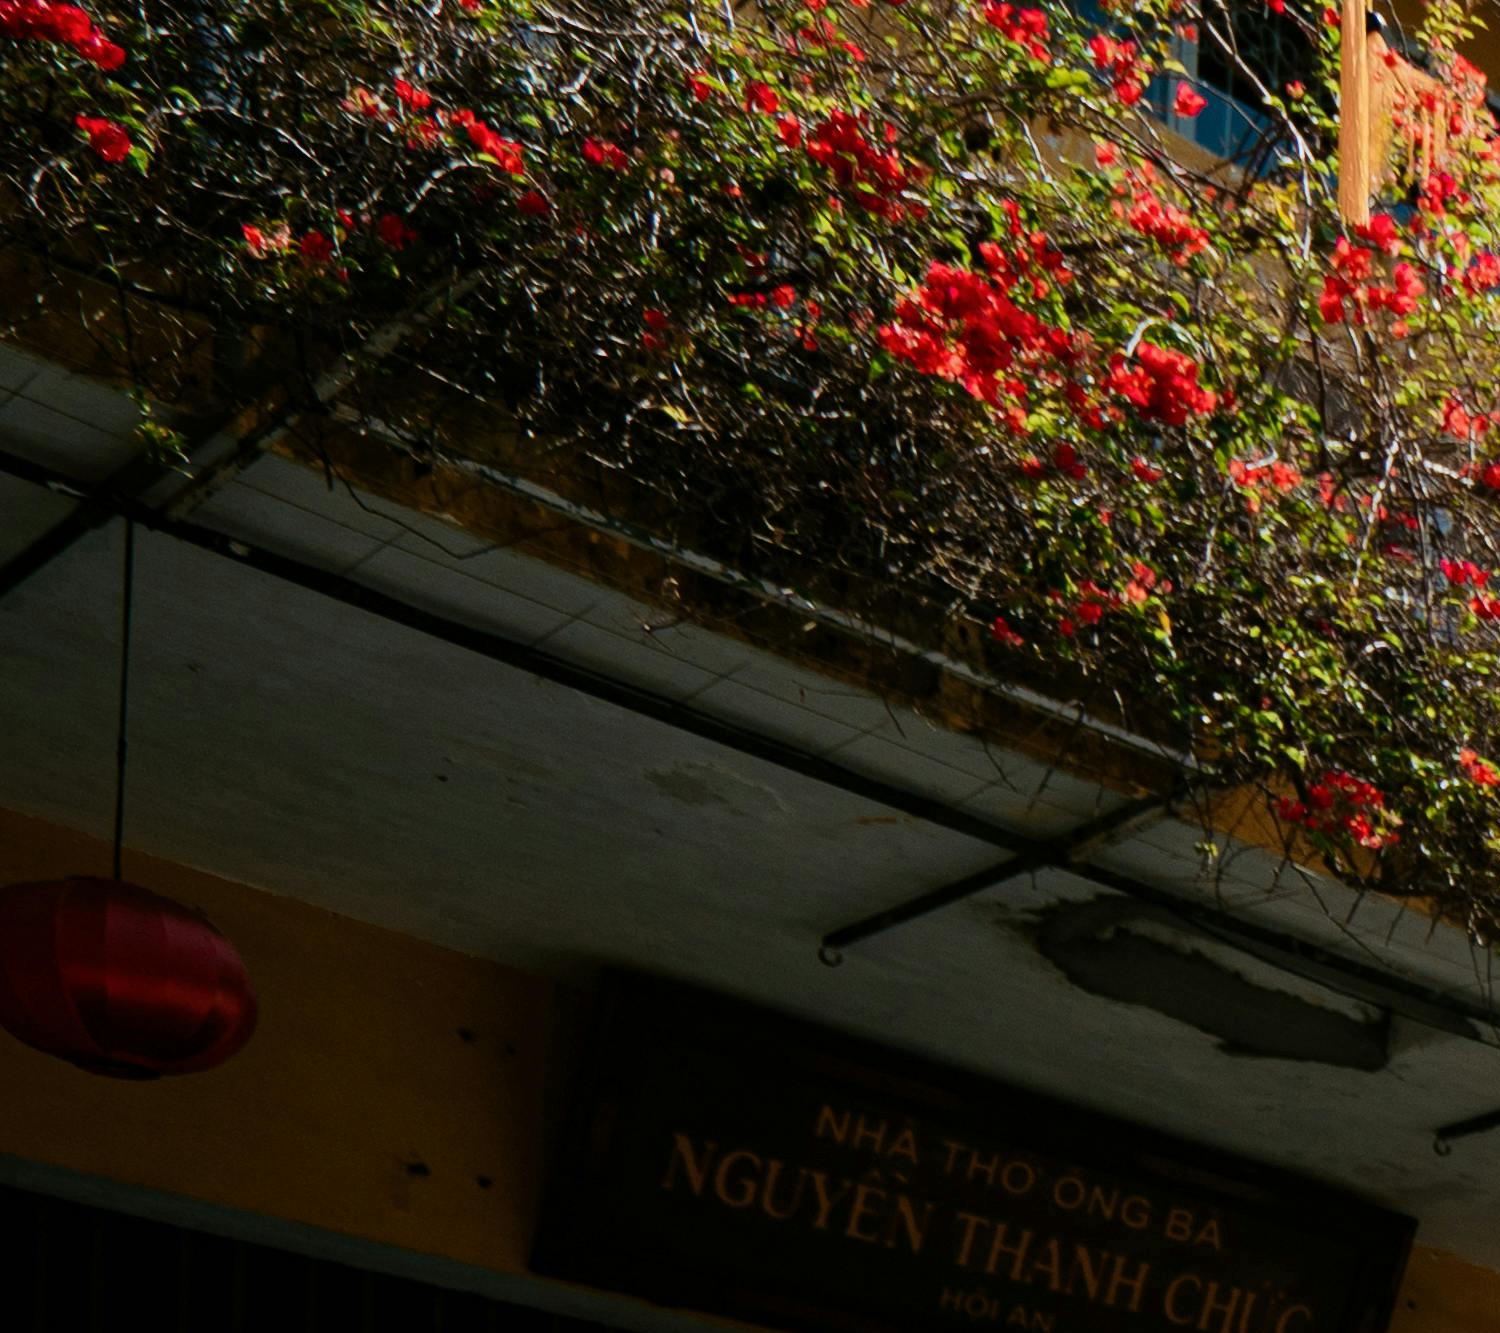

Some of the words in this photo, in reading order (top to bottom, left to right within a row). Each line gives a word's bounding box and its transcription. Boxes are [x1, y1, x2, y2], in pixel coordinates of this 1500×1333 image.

[815, 1104, 918, 1165] NHÀ
[1053, 1166, 1152, 1230] ÔNG
[955, 1210, 1151, 1313] THANH
